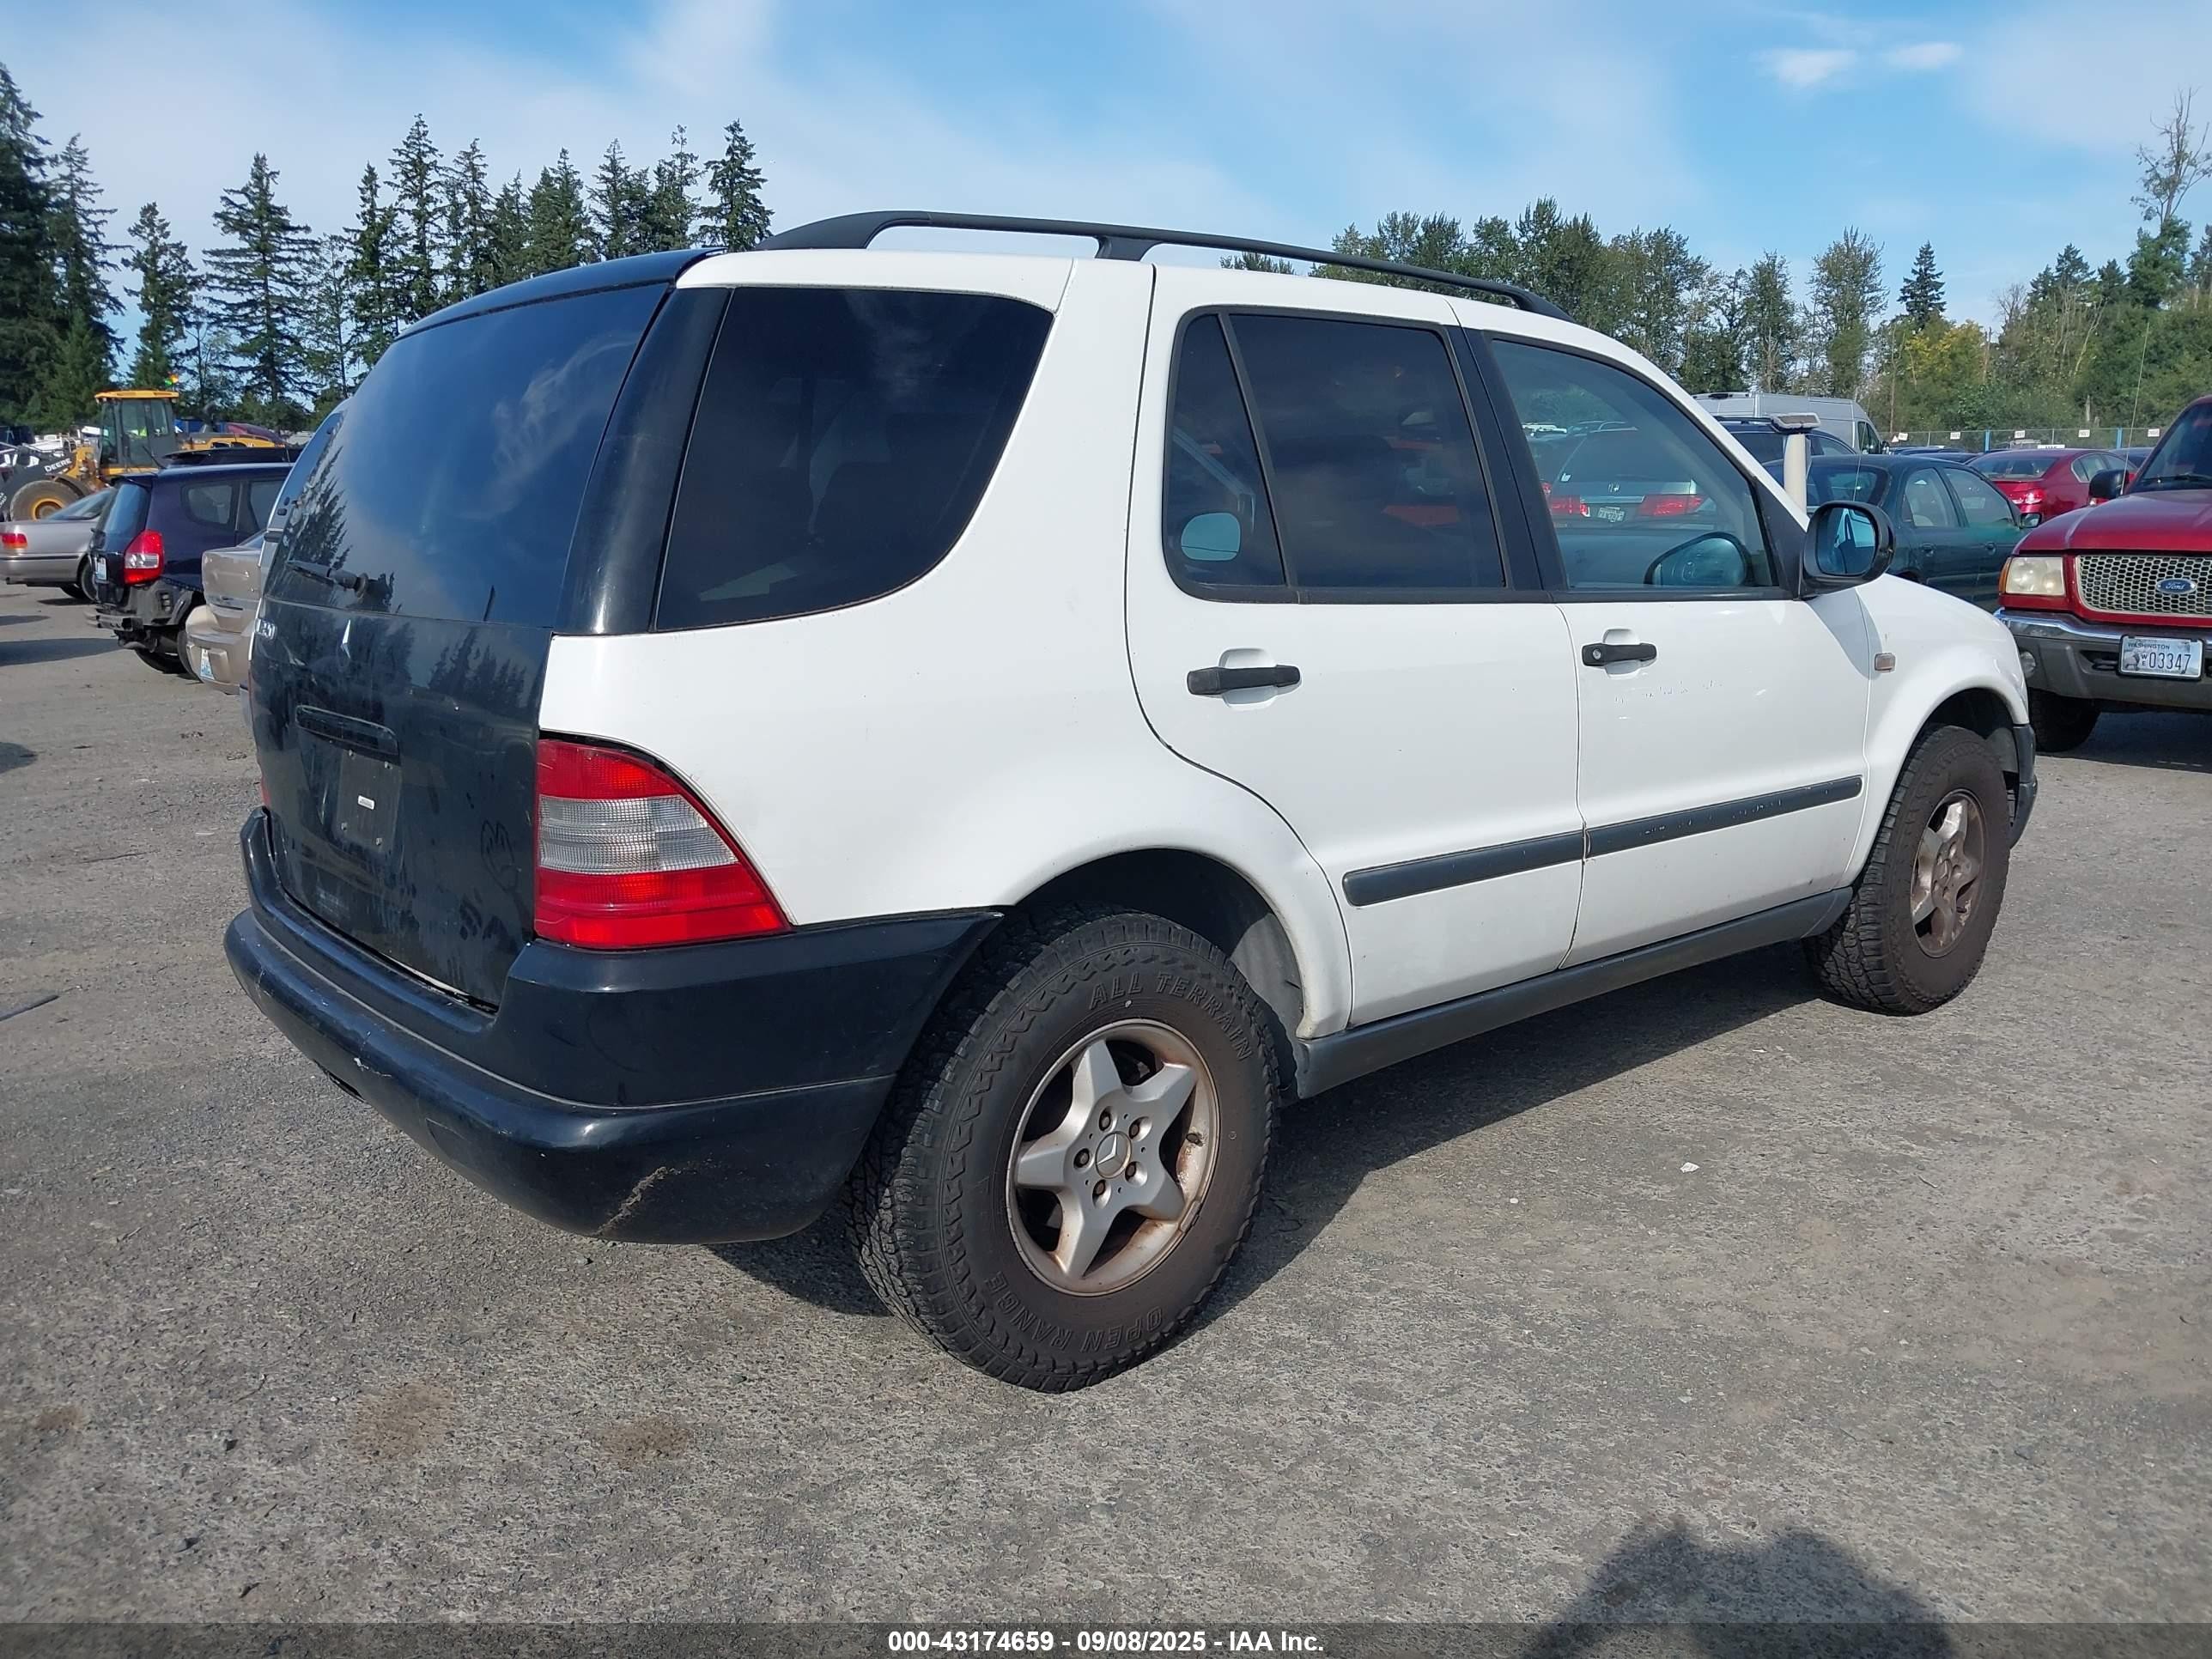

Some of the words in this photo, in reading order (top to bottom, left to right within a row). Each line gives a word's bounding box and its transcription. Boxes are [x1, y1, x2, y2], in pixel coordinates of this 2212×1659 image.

[44, 458, 72, 472] DEERE
[2166, 581, 2185, 590] Ford
[2128, 641, 2171, 650] WASHINGTON
[2149, 653, 2191, 672] 03347
[1088, 971, 1144, 1011] ALL
[1156, 973, 1253, 1061] TERRAIN
[984, 1270, 1073, 1352] RANGE
[1079, 1305, 1163, 1352] OPEN
